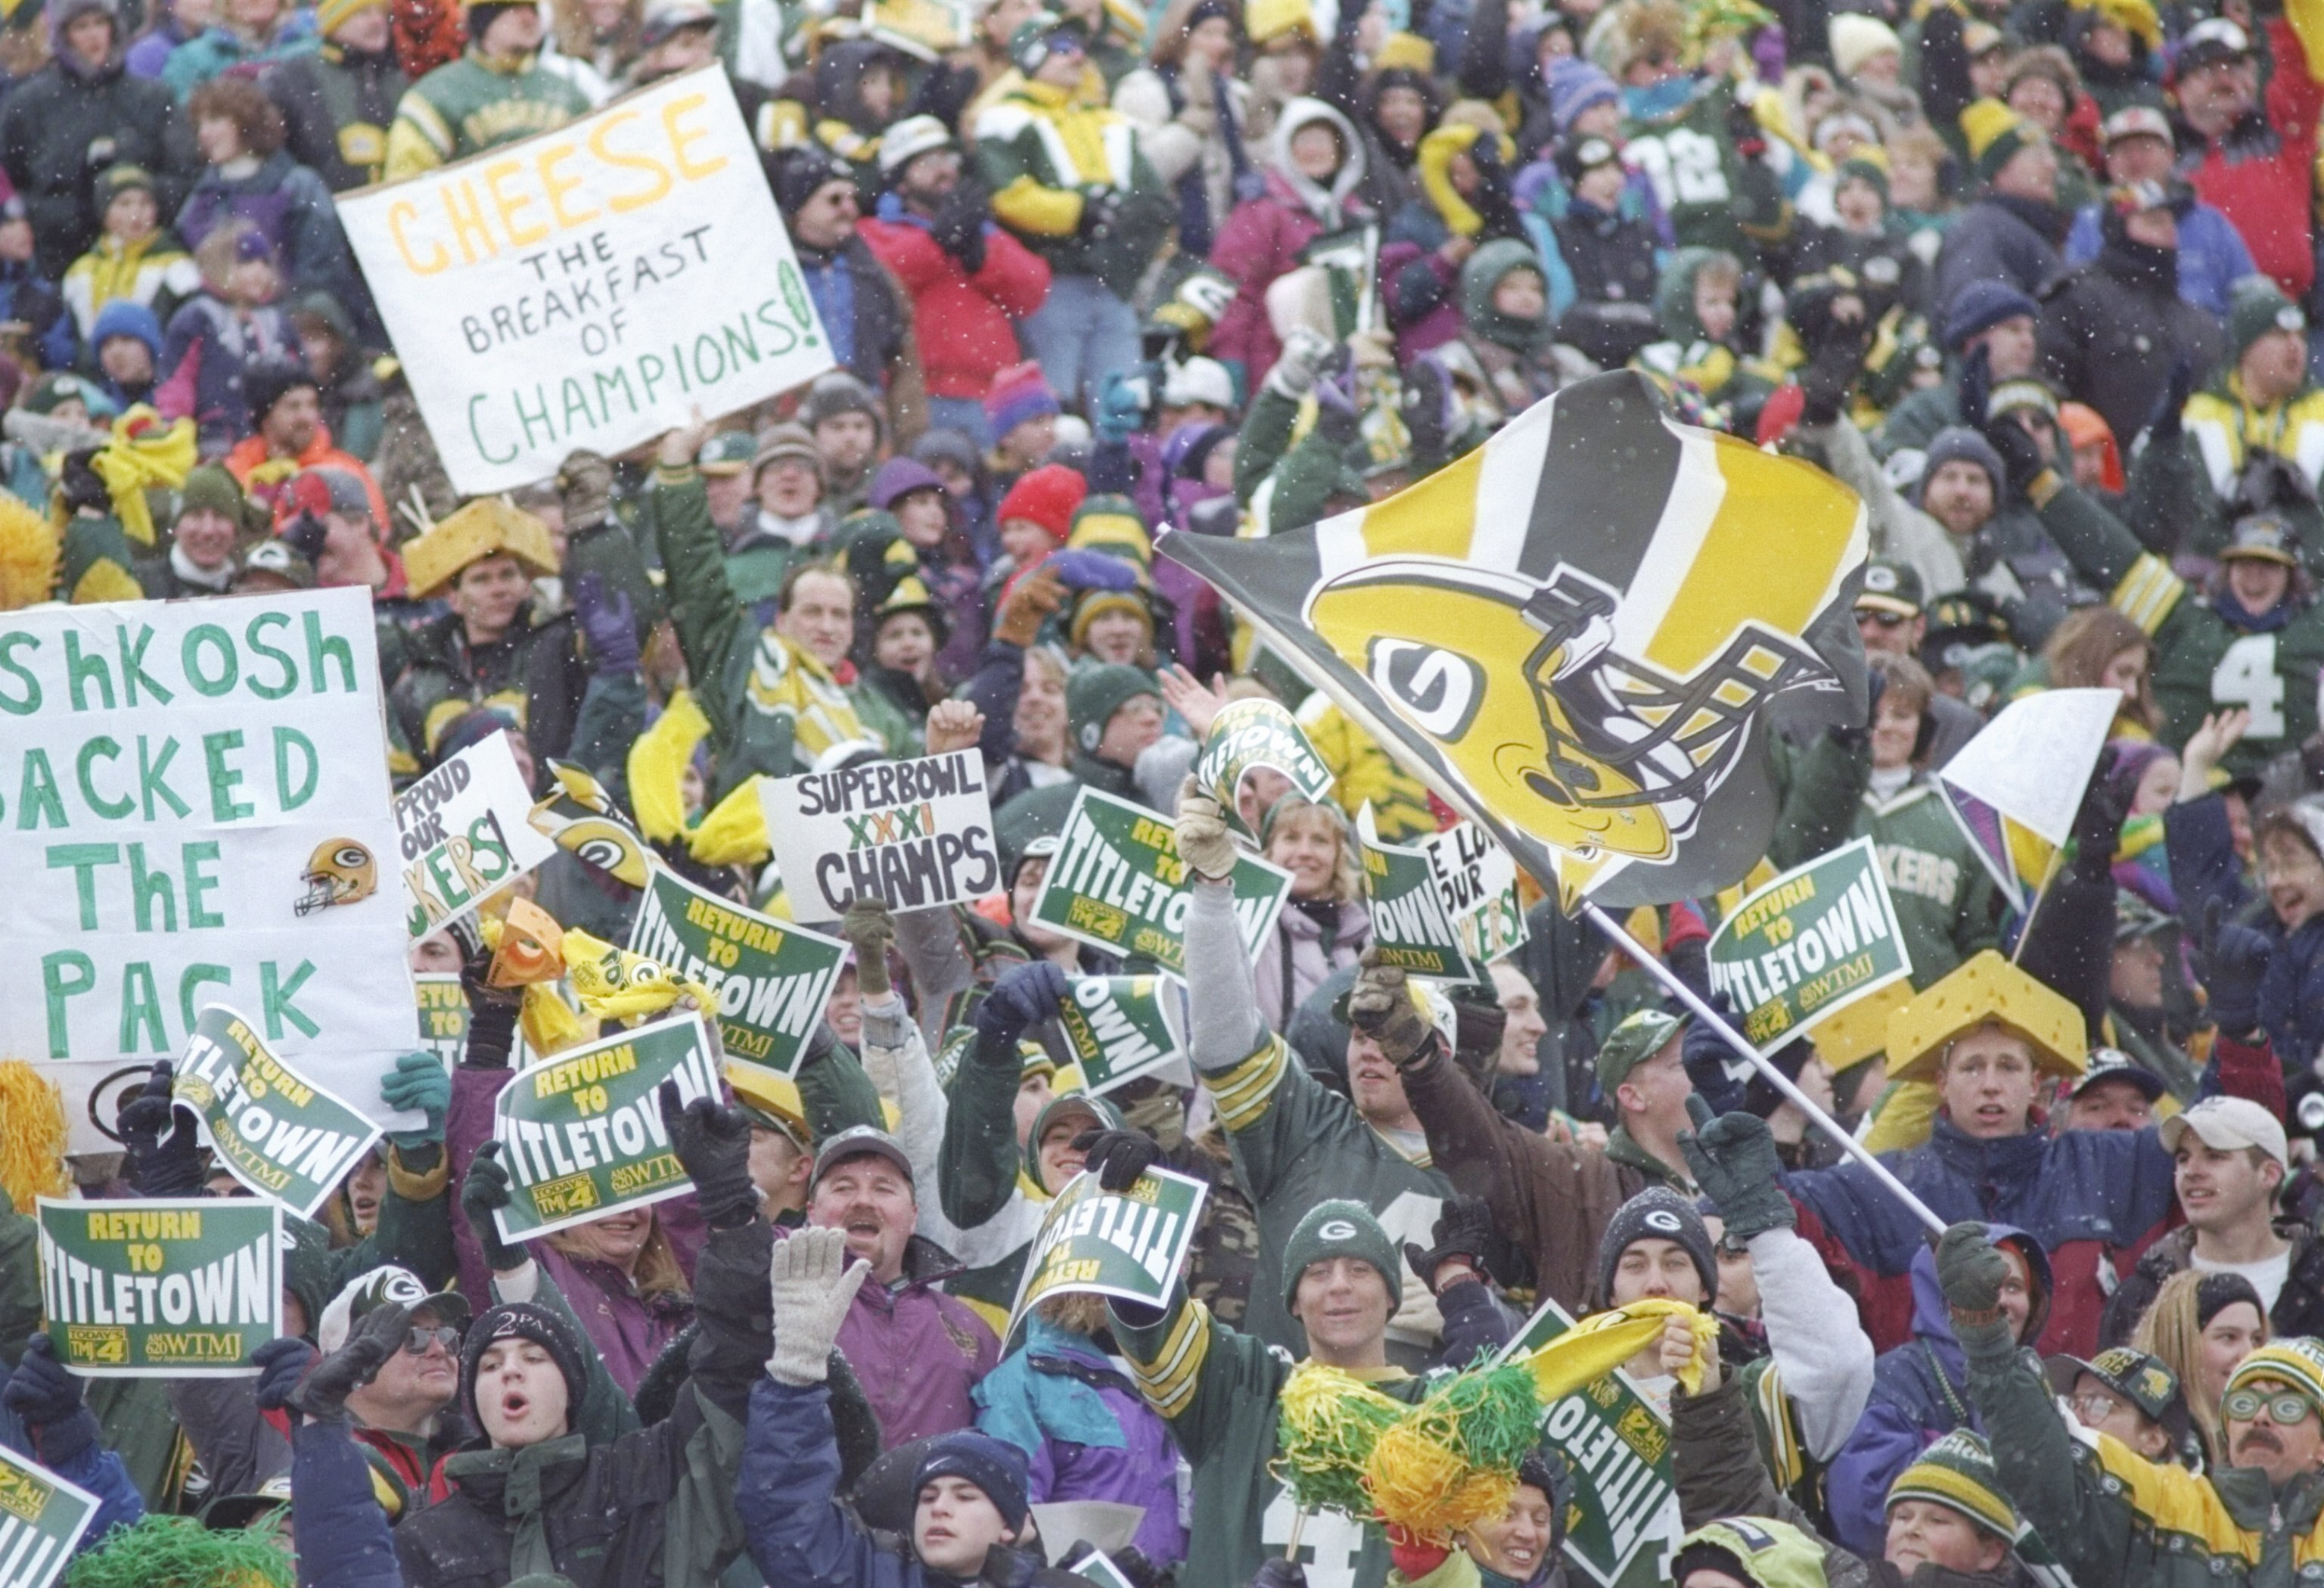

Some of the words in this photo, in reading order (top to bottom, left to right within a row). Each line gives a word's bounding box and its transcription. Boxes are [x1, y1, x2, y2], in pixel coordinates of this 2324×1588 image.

[388, 93, 729, 275] CHEESE
[520, 232, 615, 281] THE
[461, 225, 713, 355] BREAKFAST
[580, 307, 629, 356] OF
[469, 259, 818, 465] CHAMPIONS!
[2211, 632, 2285, 738] 4
[0, 726, 319, 830] ACKED
[393, 758, 471, 833] PROUD
[797, 754, 982, 816] SUPERBOWL
[401, 812, 450, 861] OUR
[843, 801, 936, 850] XXXI
[1455, 825, 1496, 866] LO
[816, 825, 998, 917] CHAMPS
[1057, 809, 1273, 958] TITLETON
[686, 896, 784, 956] RETURN
[1452, 878, 1530, 961] KERS!
[1733, 875, 1816, 940] RETURN
[1763, 915, 1794, 946] TO
[707, 936, 739, 968] TO
[41, 949, 321, 1059] PACK
[430, 1011, 463, 1036] TO
[227, 1019, 315, 1108] RETURN
[241, 1061, 266, 1099] TO
[535, 1043, 636, 1099] RETURN
[179, 1033, 359, 1185] TLETOWN
[573, 1085, 610, 1117] TO
[535, 1176, 590, 1200] TODAY'S
[567, 1185, 595, 1208] 4
[89, 1212, 201, 1241] RETURN
[1034, 1196, 1179, 1285] TITLETO
[1319, 1220, 1356, 1241] G
[42, 1223, 269, 1325] TITLETOWN
[127, 1244, 164, 1273] TO
[70, 1330, 124, 1340] TODAY'S
[97, 1340, 124, 1363] 4
[145, 1341, 168, 1355] 620
[163, 1332, 242, 1361] WTMJ
[1626, 1407, 1651, 1431] 4
[1537, 1395, 1667, 1562] TITLETO
